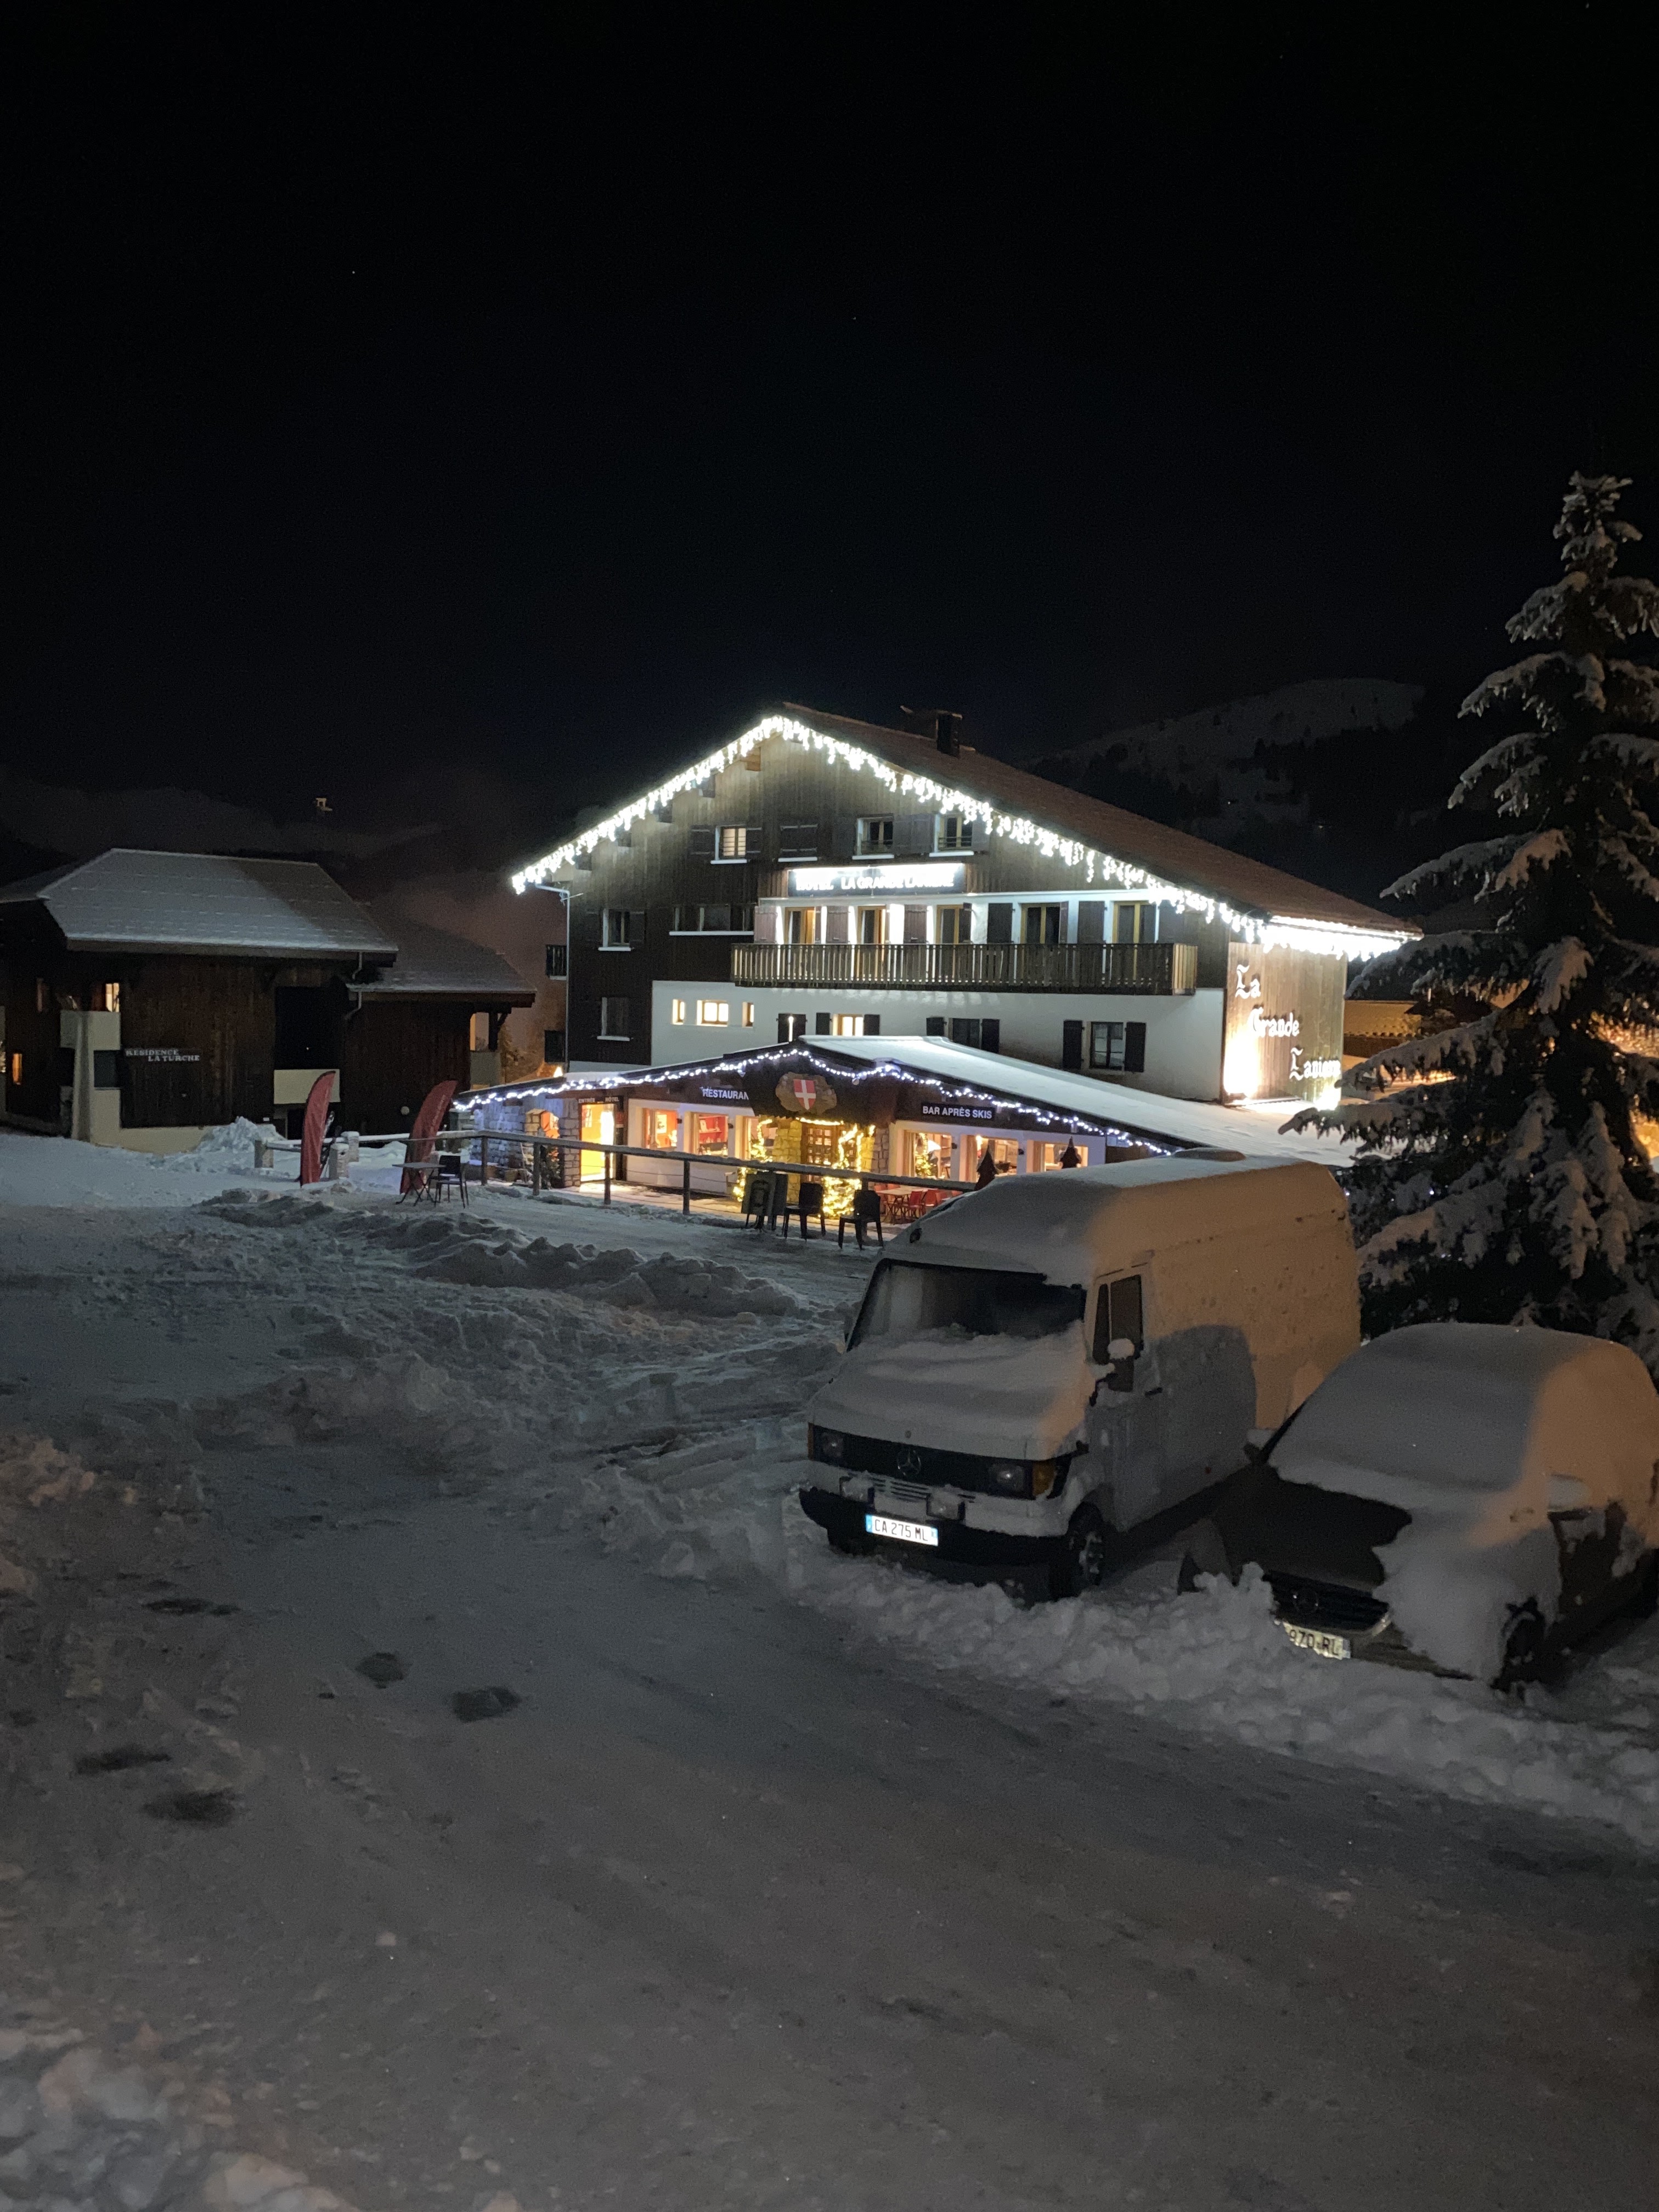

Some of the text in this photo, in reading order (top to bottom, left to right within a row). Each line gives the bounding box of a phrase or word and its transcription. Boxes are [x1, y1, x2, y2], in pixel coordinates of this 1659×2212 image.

[841, 877, 856, 889] LA
[1235, 964, 1261, 999] La
[1248, 1007, 1300, 1038] Grande
[922, 1105, 940, 1115] BAR
[972, 1109, 992, 1119] SKIS
